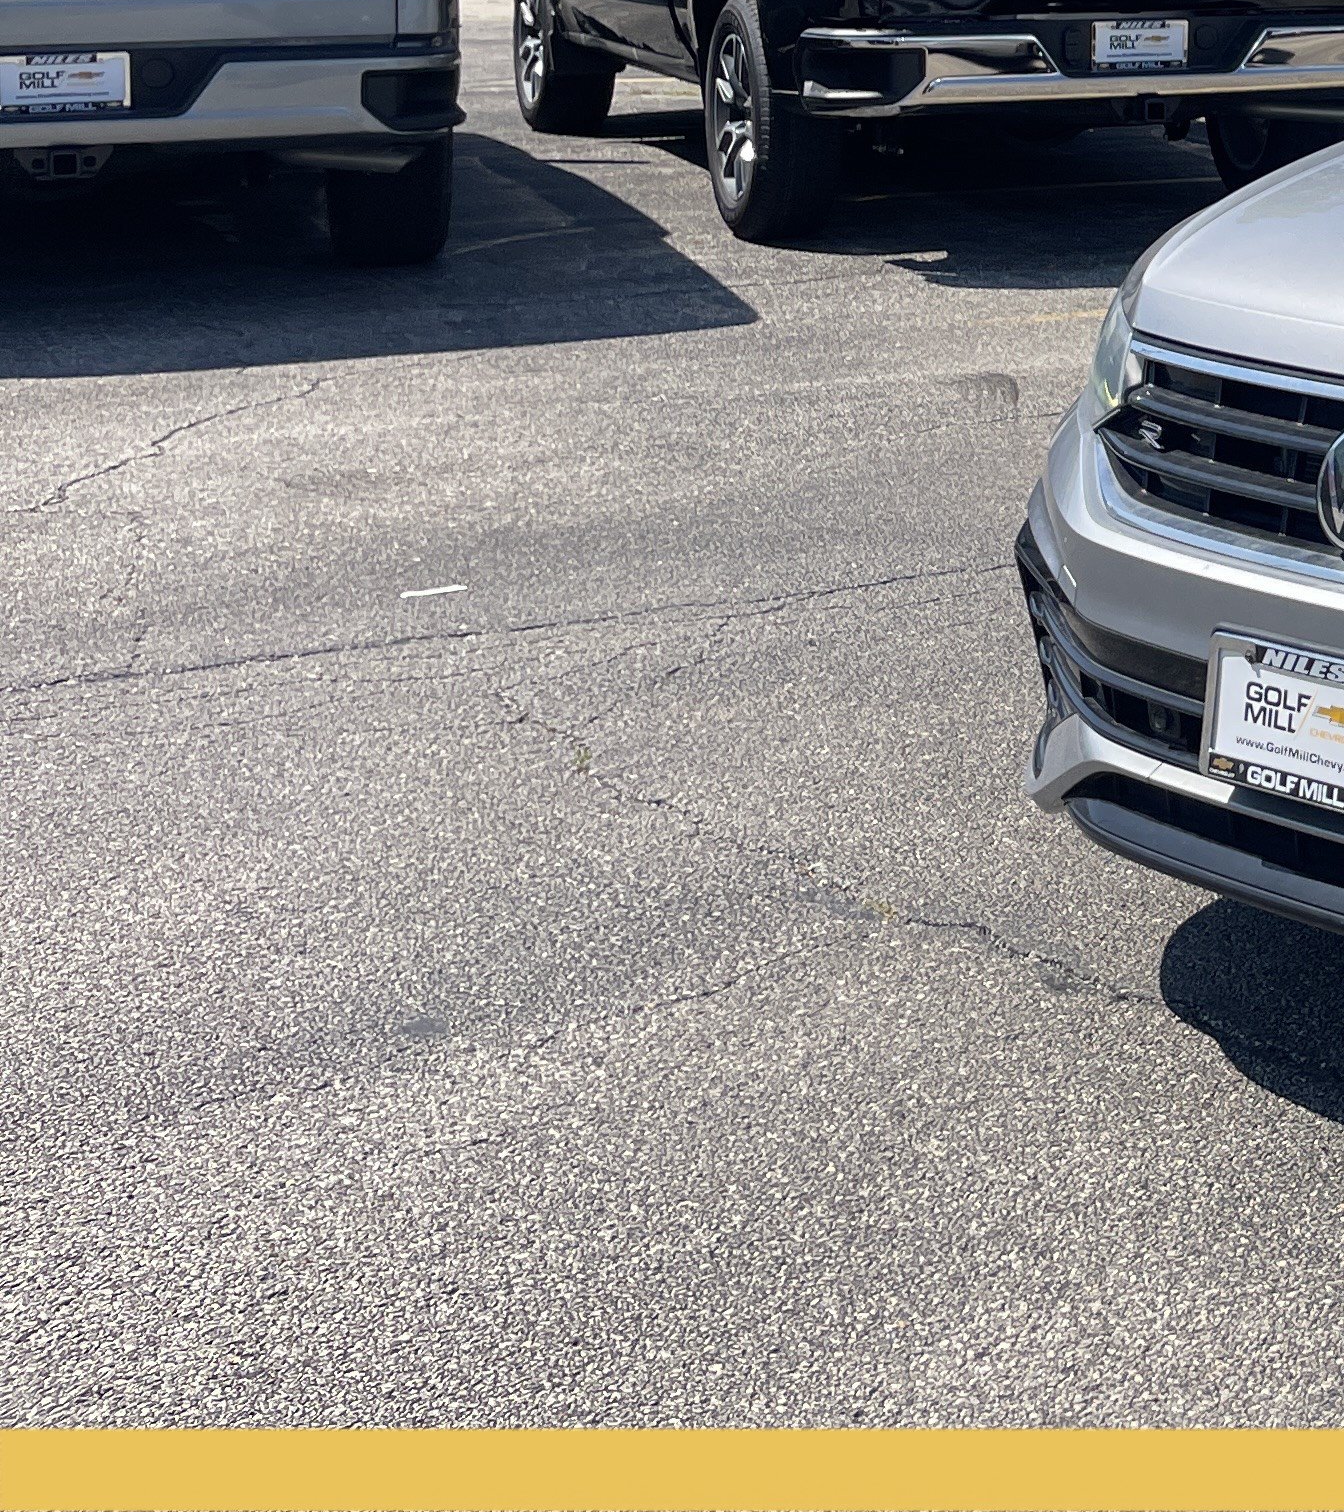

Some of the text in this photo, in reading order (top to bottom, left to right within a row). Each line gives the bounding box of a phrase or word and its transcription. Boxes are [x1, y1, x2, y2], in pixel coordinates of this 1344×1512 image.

[19, 70, 66, 81] GOLF
[19, 79, 58, 90] MILL
[1245, 681, 1312, 714] GOLF
[1243, 701, 1297, 734] MILL
[1246, 764, 1344, 809] GOLF MILL
